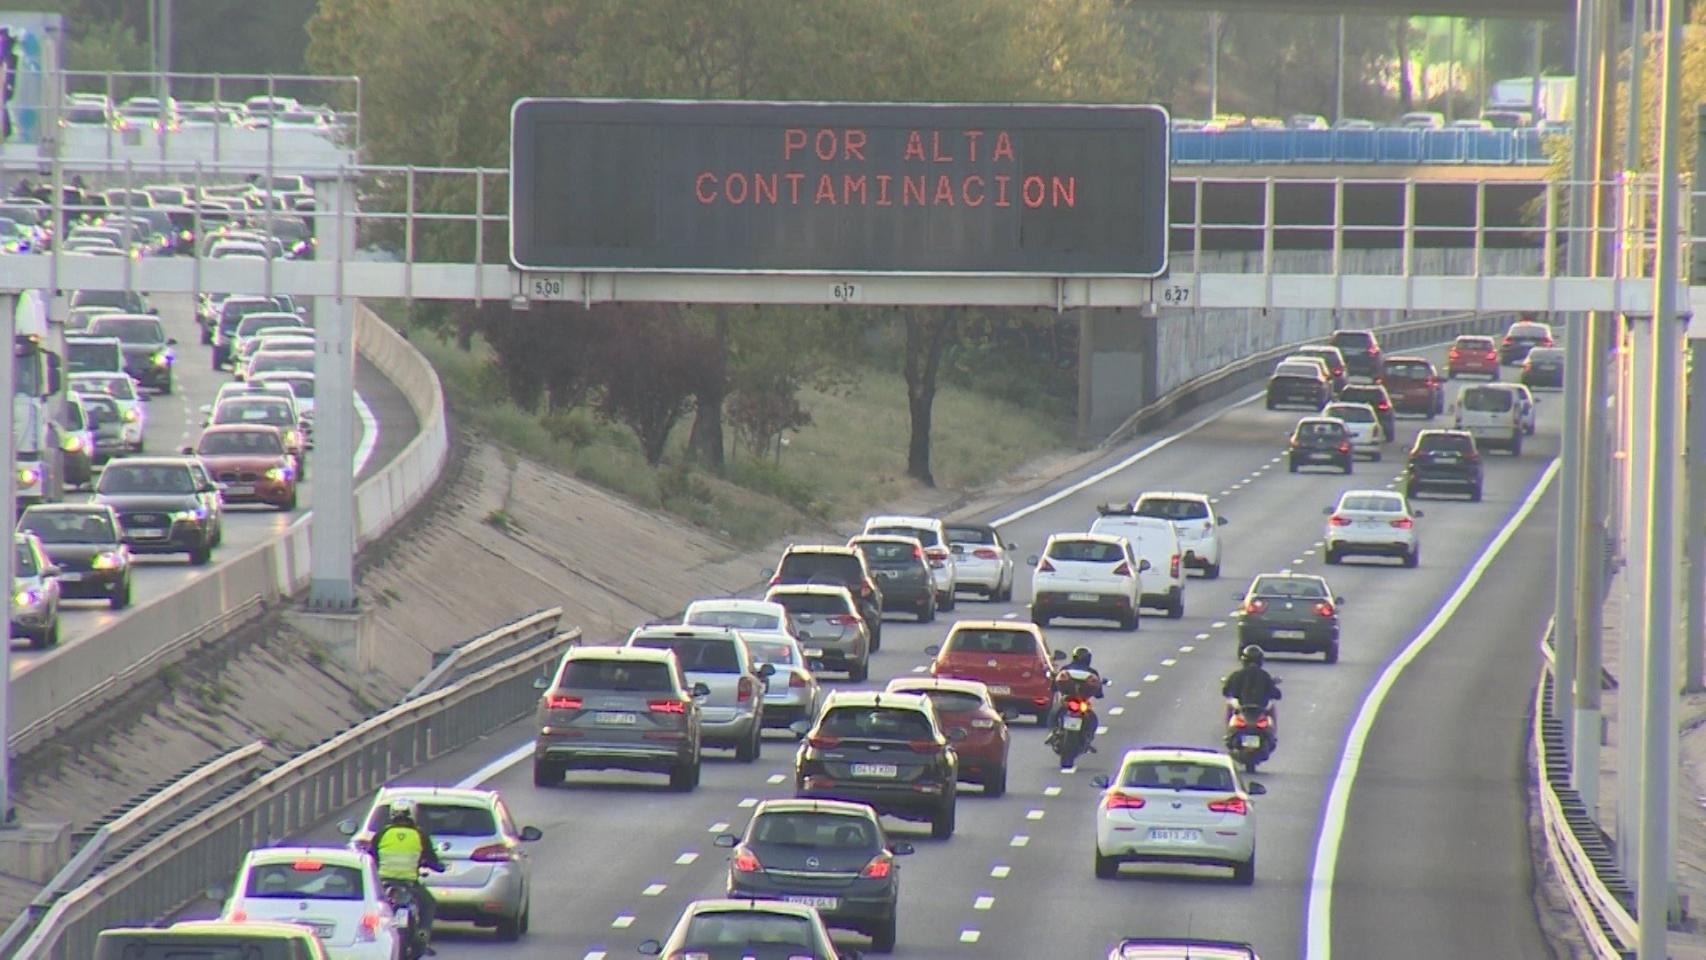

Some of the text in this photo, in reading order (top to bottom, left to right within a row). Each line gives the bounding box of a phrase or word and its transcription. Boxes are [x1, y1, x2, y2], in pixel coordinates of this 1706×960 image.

[785, 129, 1014, 164] POR ALTA
[695, 173, 1077, 208] CONTAMINACION
